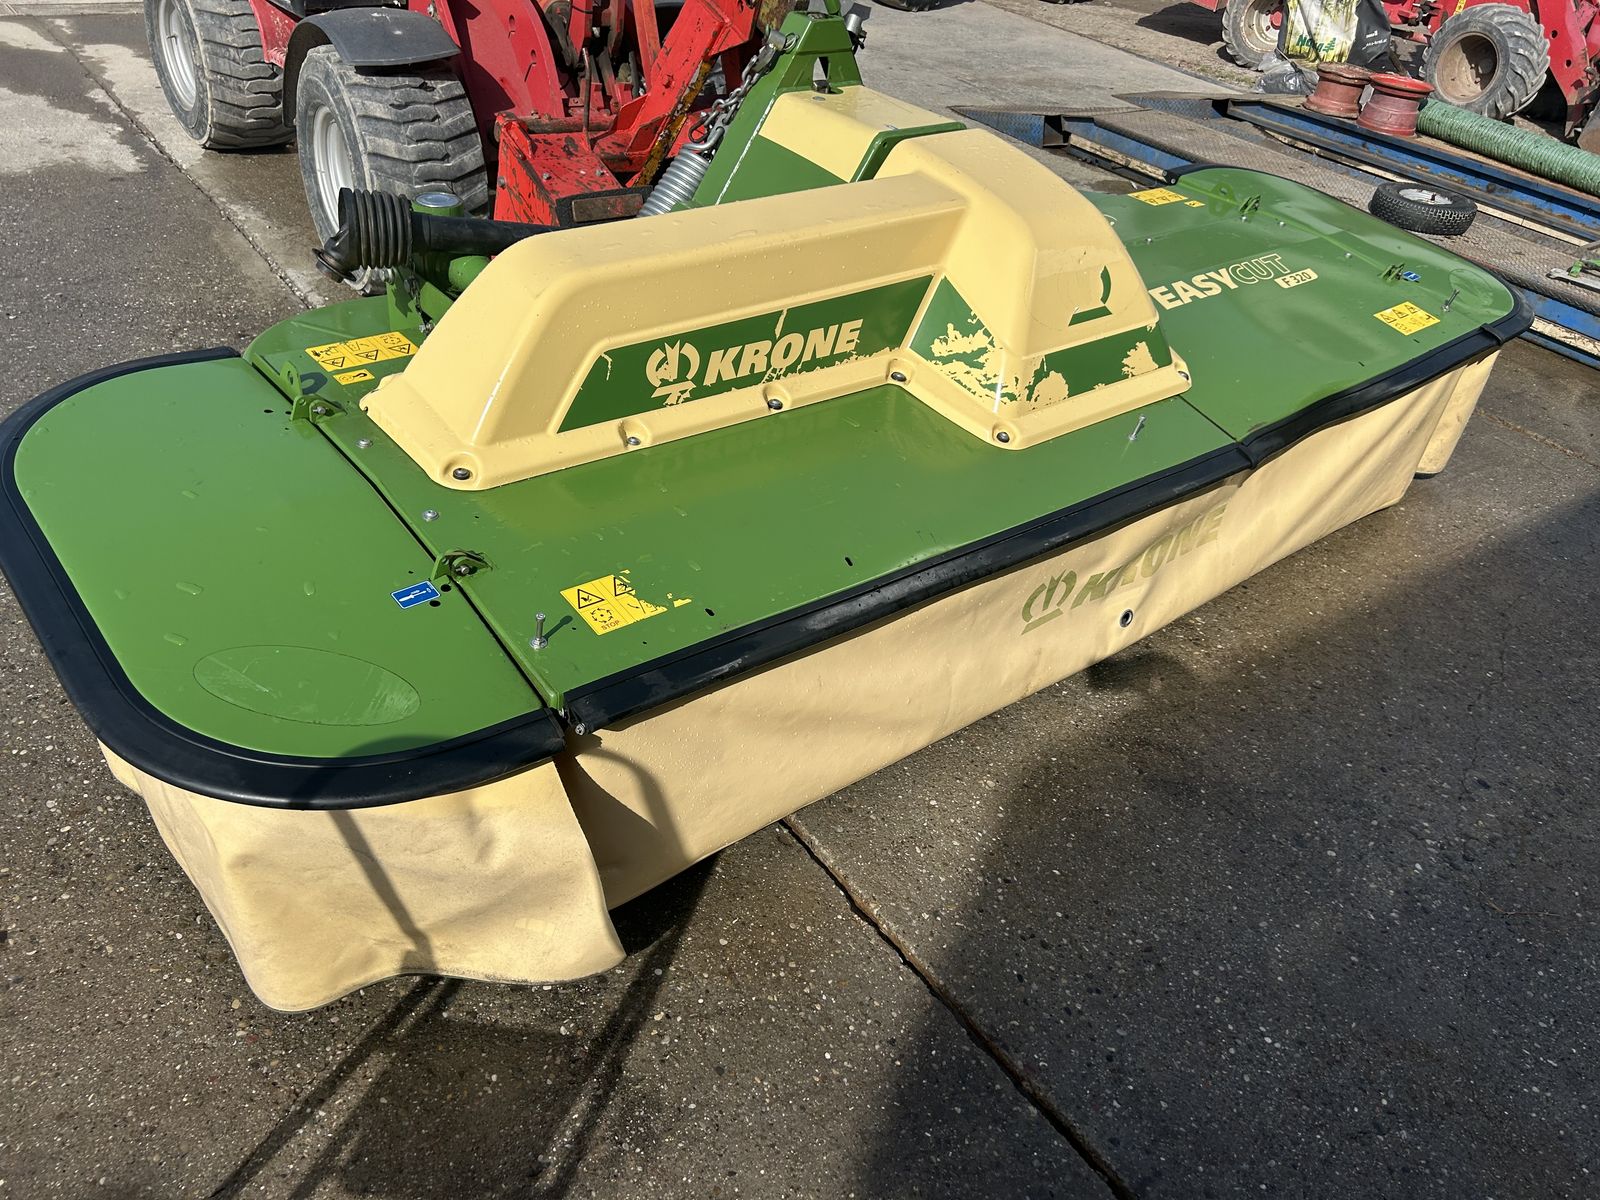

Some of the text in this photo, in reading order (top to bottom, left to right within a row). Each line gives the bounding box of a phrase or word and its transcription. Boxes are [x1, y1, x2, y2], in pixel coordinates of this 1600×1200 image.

[1148, 253, 1290, 310] EASYCUT
[1292, 271, 1313, 284] 320
[703, 319, 863, 386] KRONE
[601, 620, 620, 630] STOP
